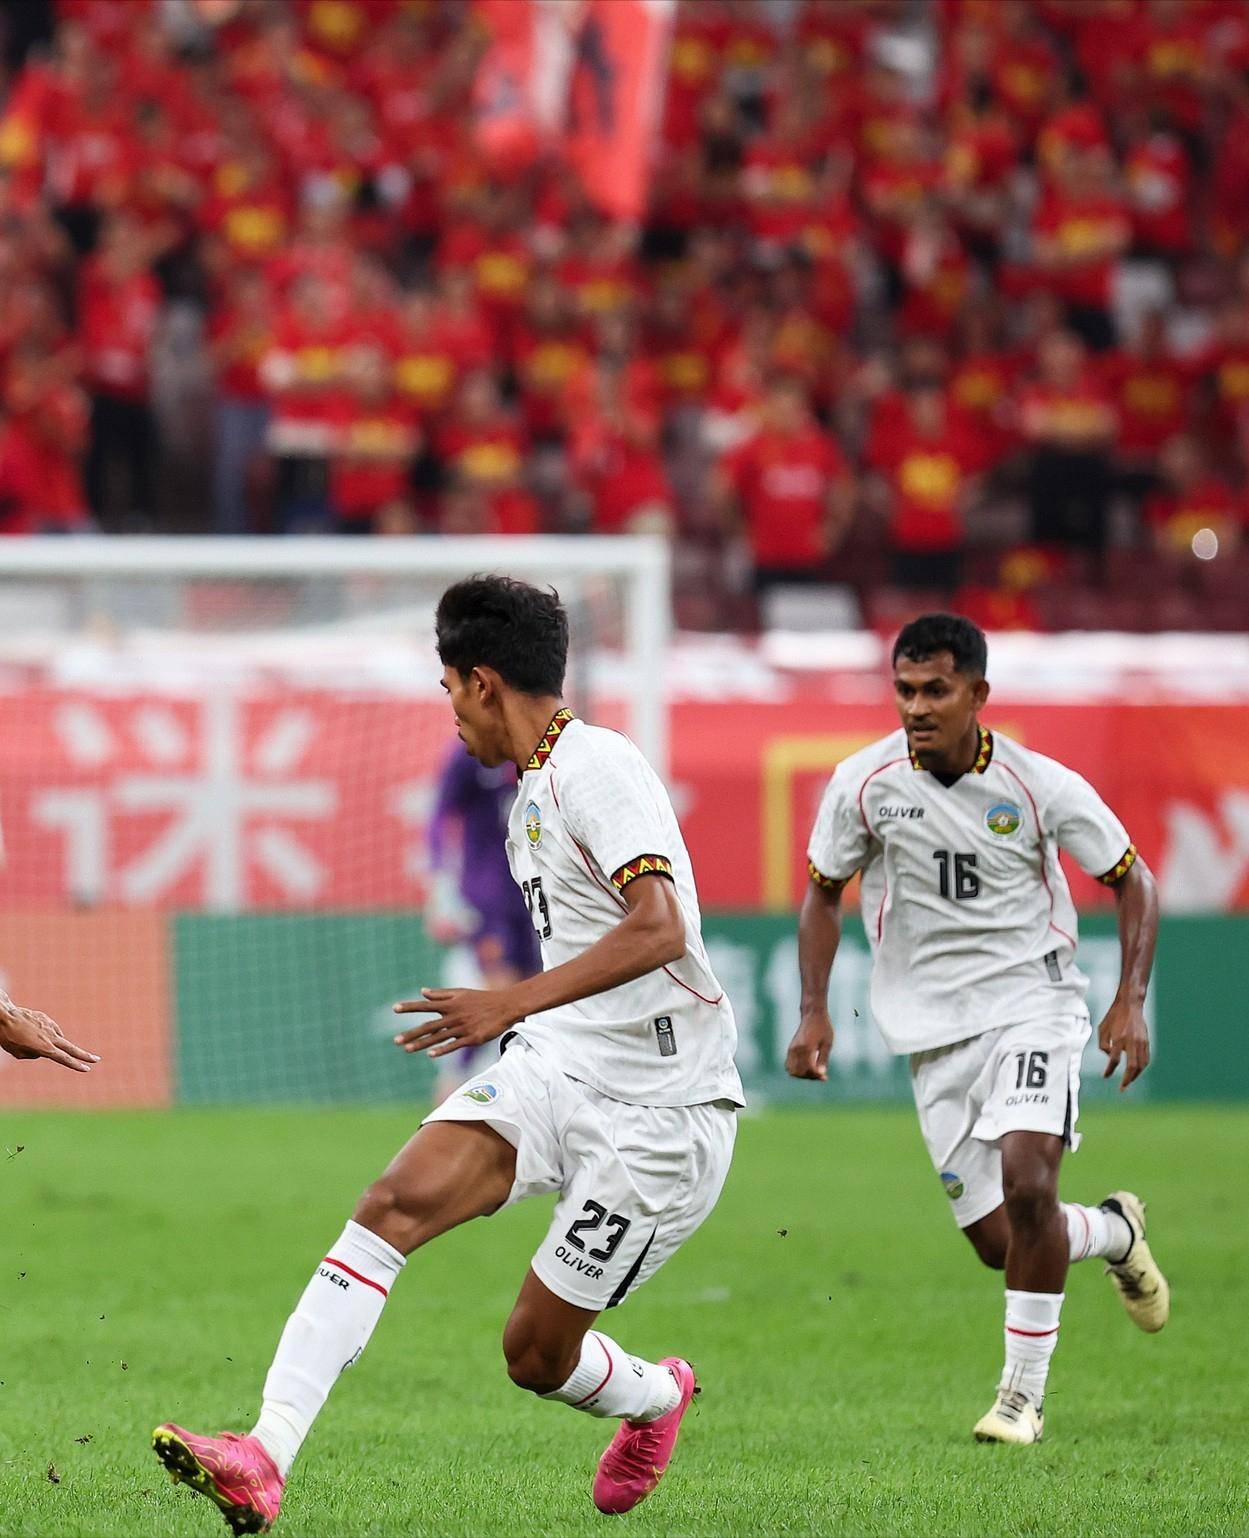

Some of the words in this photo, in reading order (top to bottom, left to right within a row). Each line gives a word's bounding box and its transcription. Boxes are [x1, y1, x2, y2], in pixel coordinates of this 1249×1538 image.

[933, 850, 980, 900] 16
[1015, 1051, 1049, 1090] 16
[564, 1199, 632, 1264] 23
